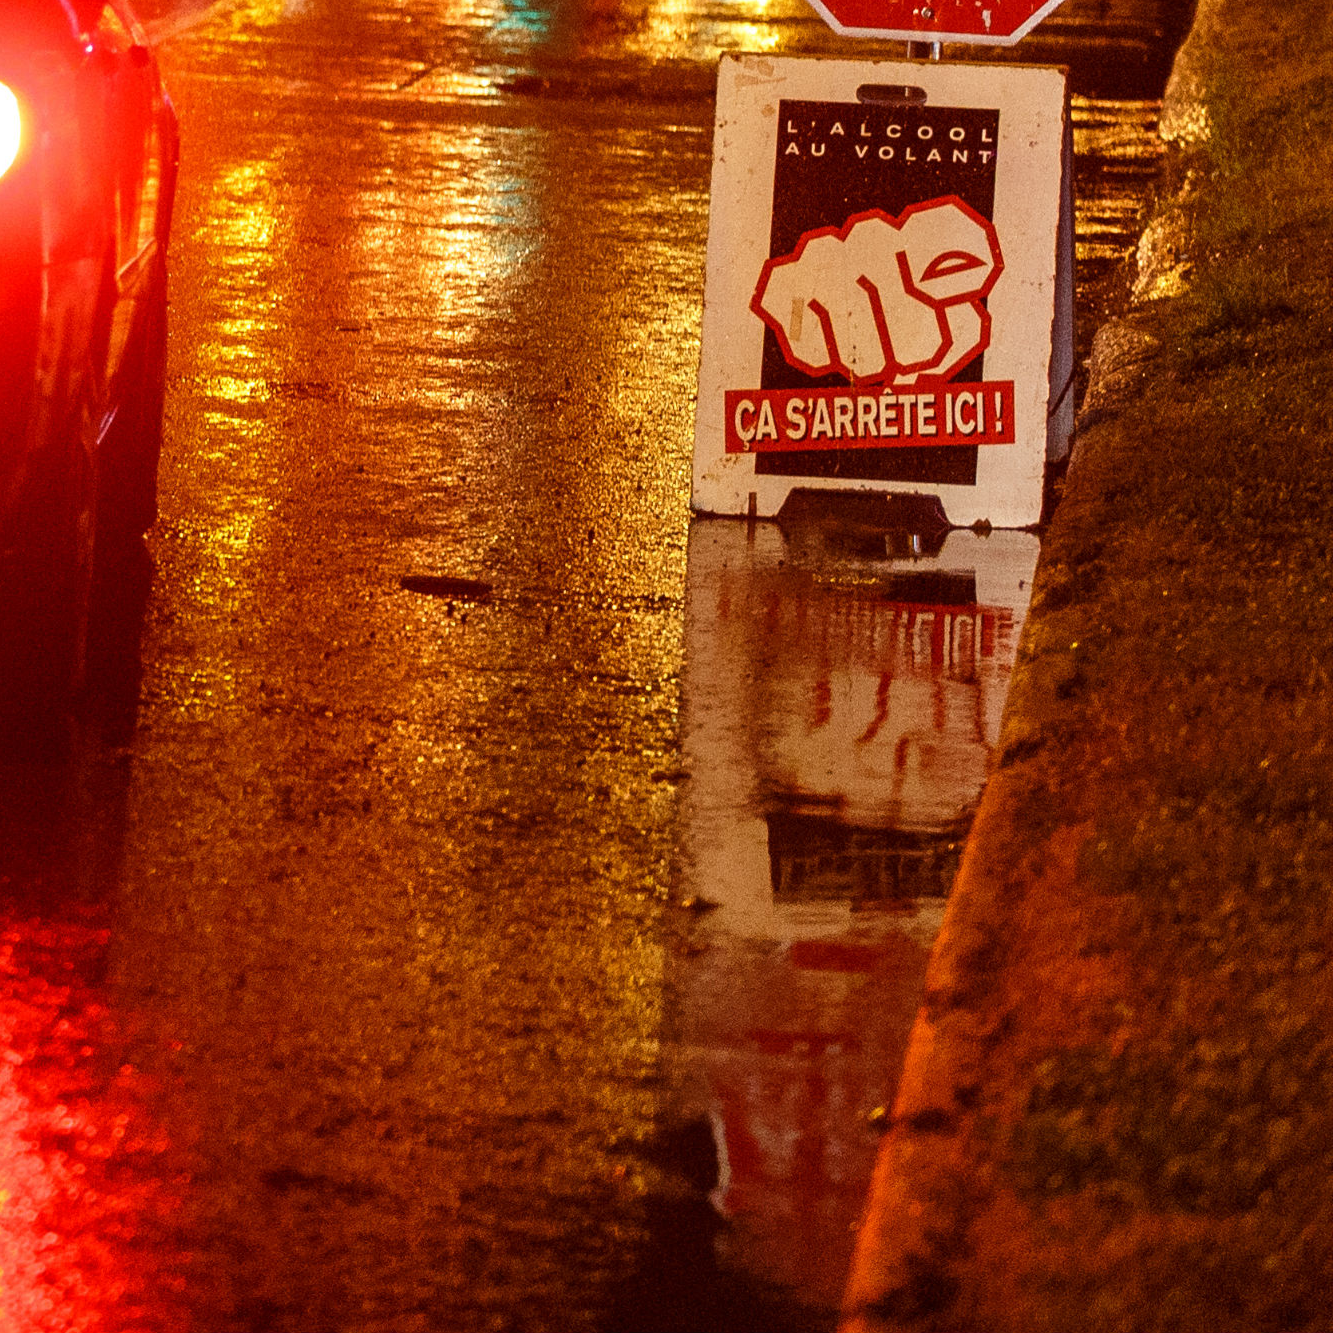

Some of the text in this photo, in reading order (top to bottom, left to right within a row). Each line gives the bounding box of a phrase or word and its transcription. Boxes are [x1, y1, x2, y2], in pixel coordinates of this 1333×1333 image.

[786, 120, 993, 143] L'ALCOOL
[784, 141, 994, 164] AU VOLANT
[734, 398, 779, 451] ÇA
[784, 387, 937, 441] S'ARRÊTE
[945, 390, 984, 436] ICI
